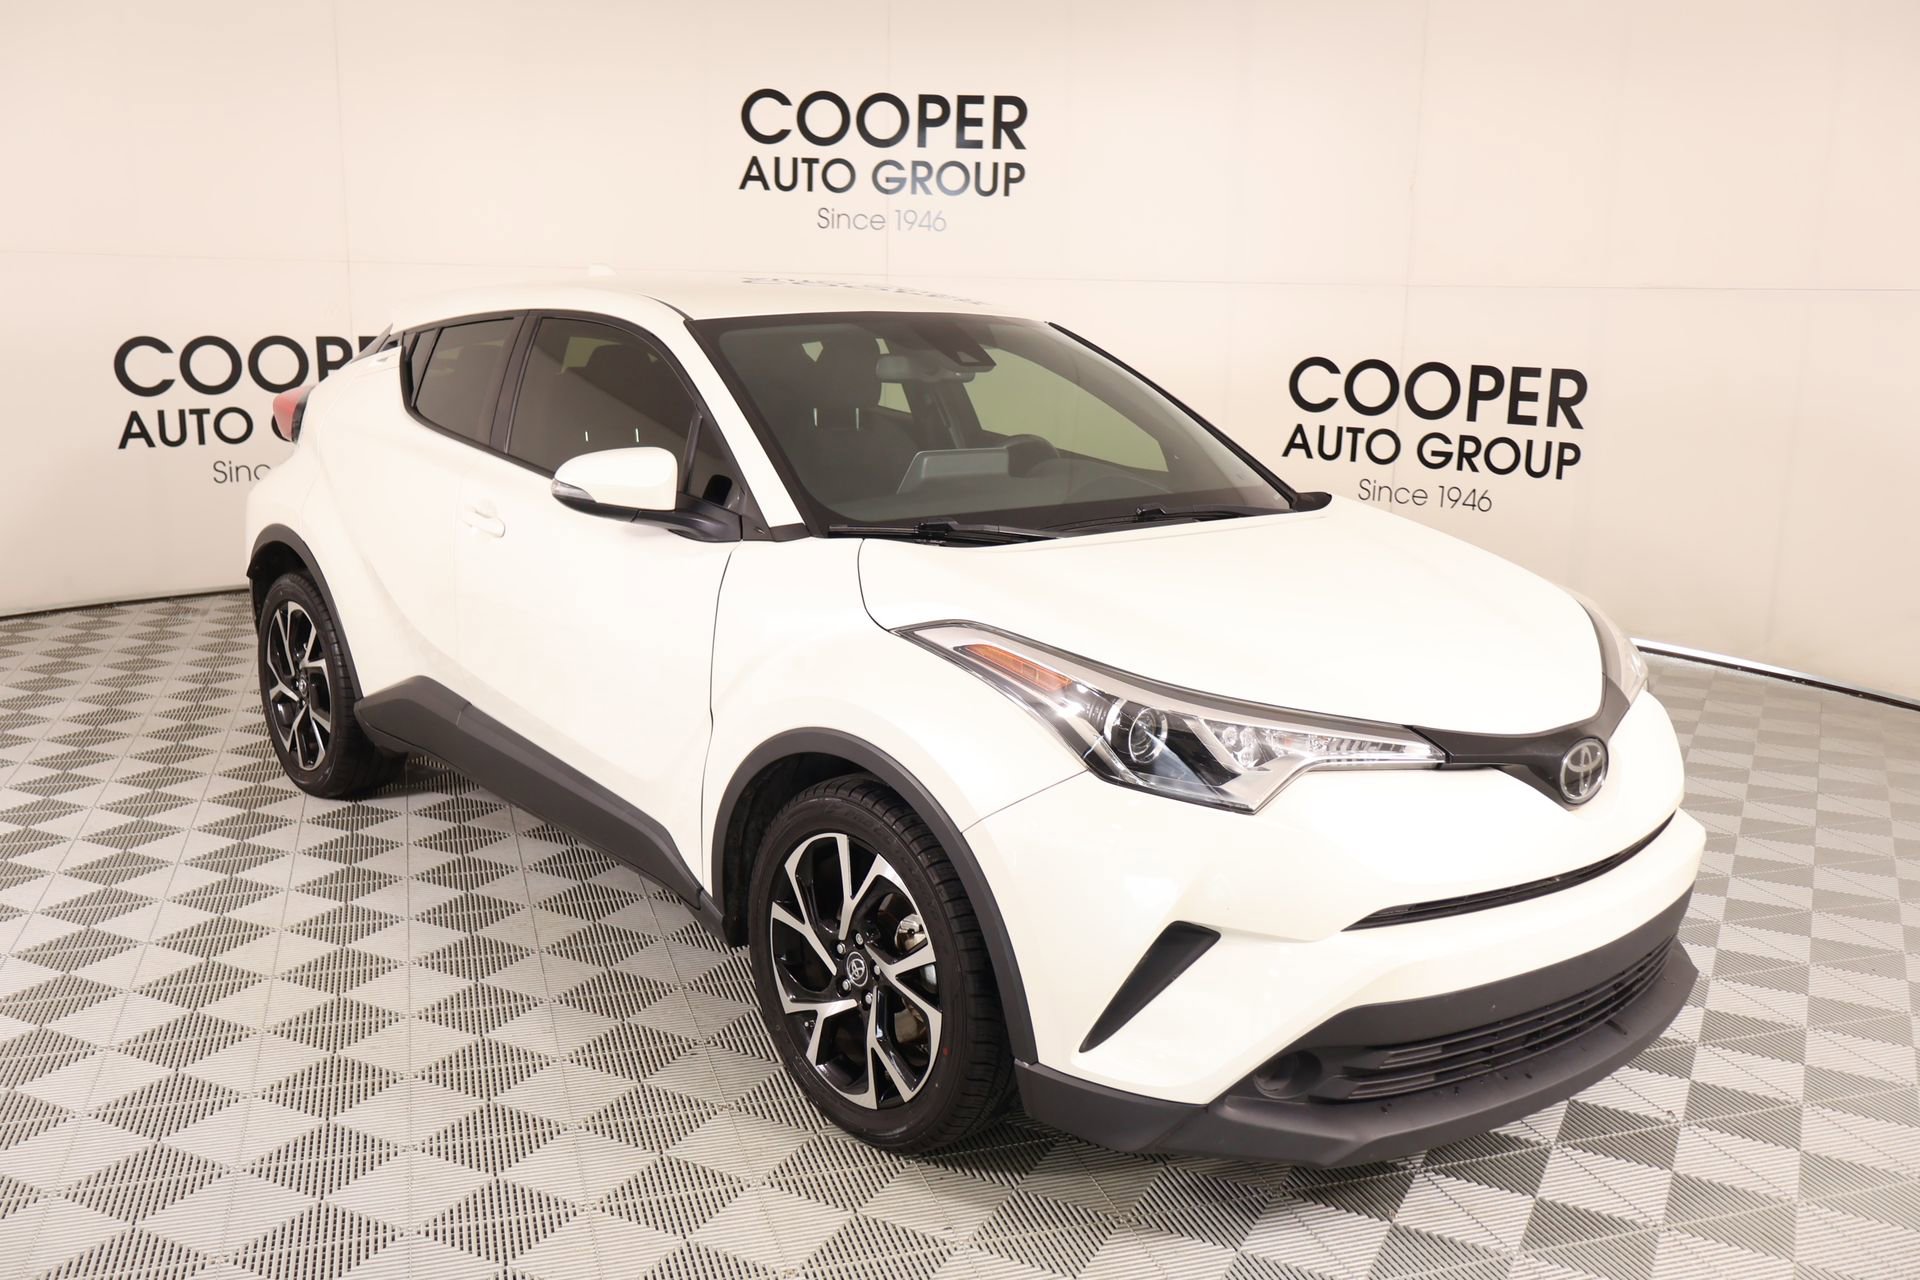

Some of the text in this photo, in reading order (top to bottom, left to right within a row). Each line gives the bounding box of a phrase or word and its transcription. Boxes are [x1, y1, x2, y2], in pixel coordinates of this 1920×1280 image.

[741, 88, 1028, 150] COOPER
[738, 156, 1026, 197] AUTO GROUP
[817, 207, 947, 232] Since 1946
[1289, 356, 1588, 430] COOPER
[118, 407, 254, 450] AUTO
[1282, 423, 1581, 480] AUTO GROUP
[1358, 478, 1493, 512] Since 1946
